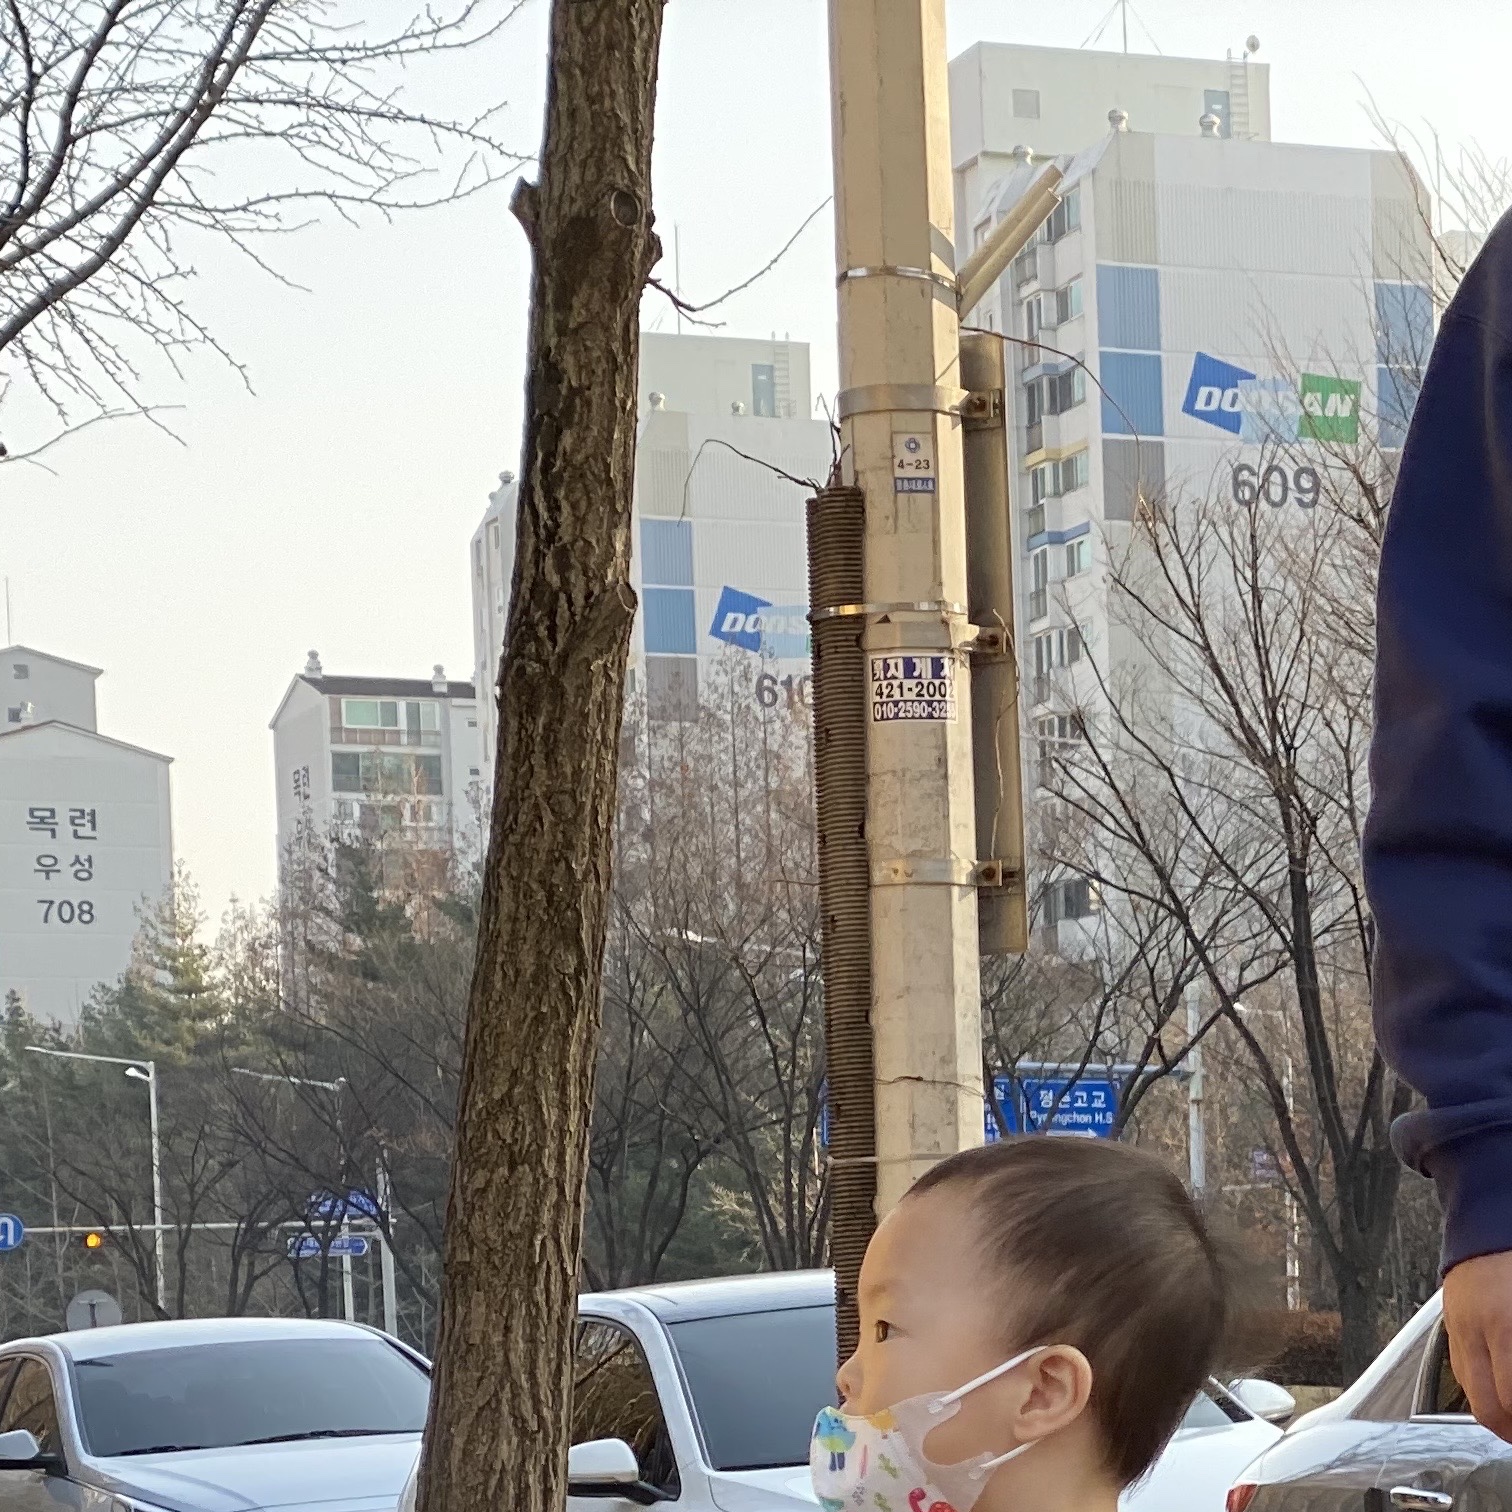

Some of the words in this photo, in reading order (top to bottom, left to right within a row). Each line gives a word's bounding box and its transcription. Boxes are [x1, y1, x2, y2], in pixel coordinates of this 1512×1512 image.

[897, 459, 930, 470] 4-23
[1232, 462, 1321, 509] 609
[720, 612, 810, 635] DOOS
[26, 807, 97, 840] 목련
[34, 854, 93, 881] 우성
[37, 900, 95, 924] 708
[1030, 1110, 1093, 1126] Pyengchon
